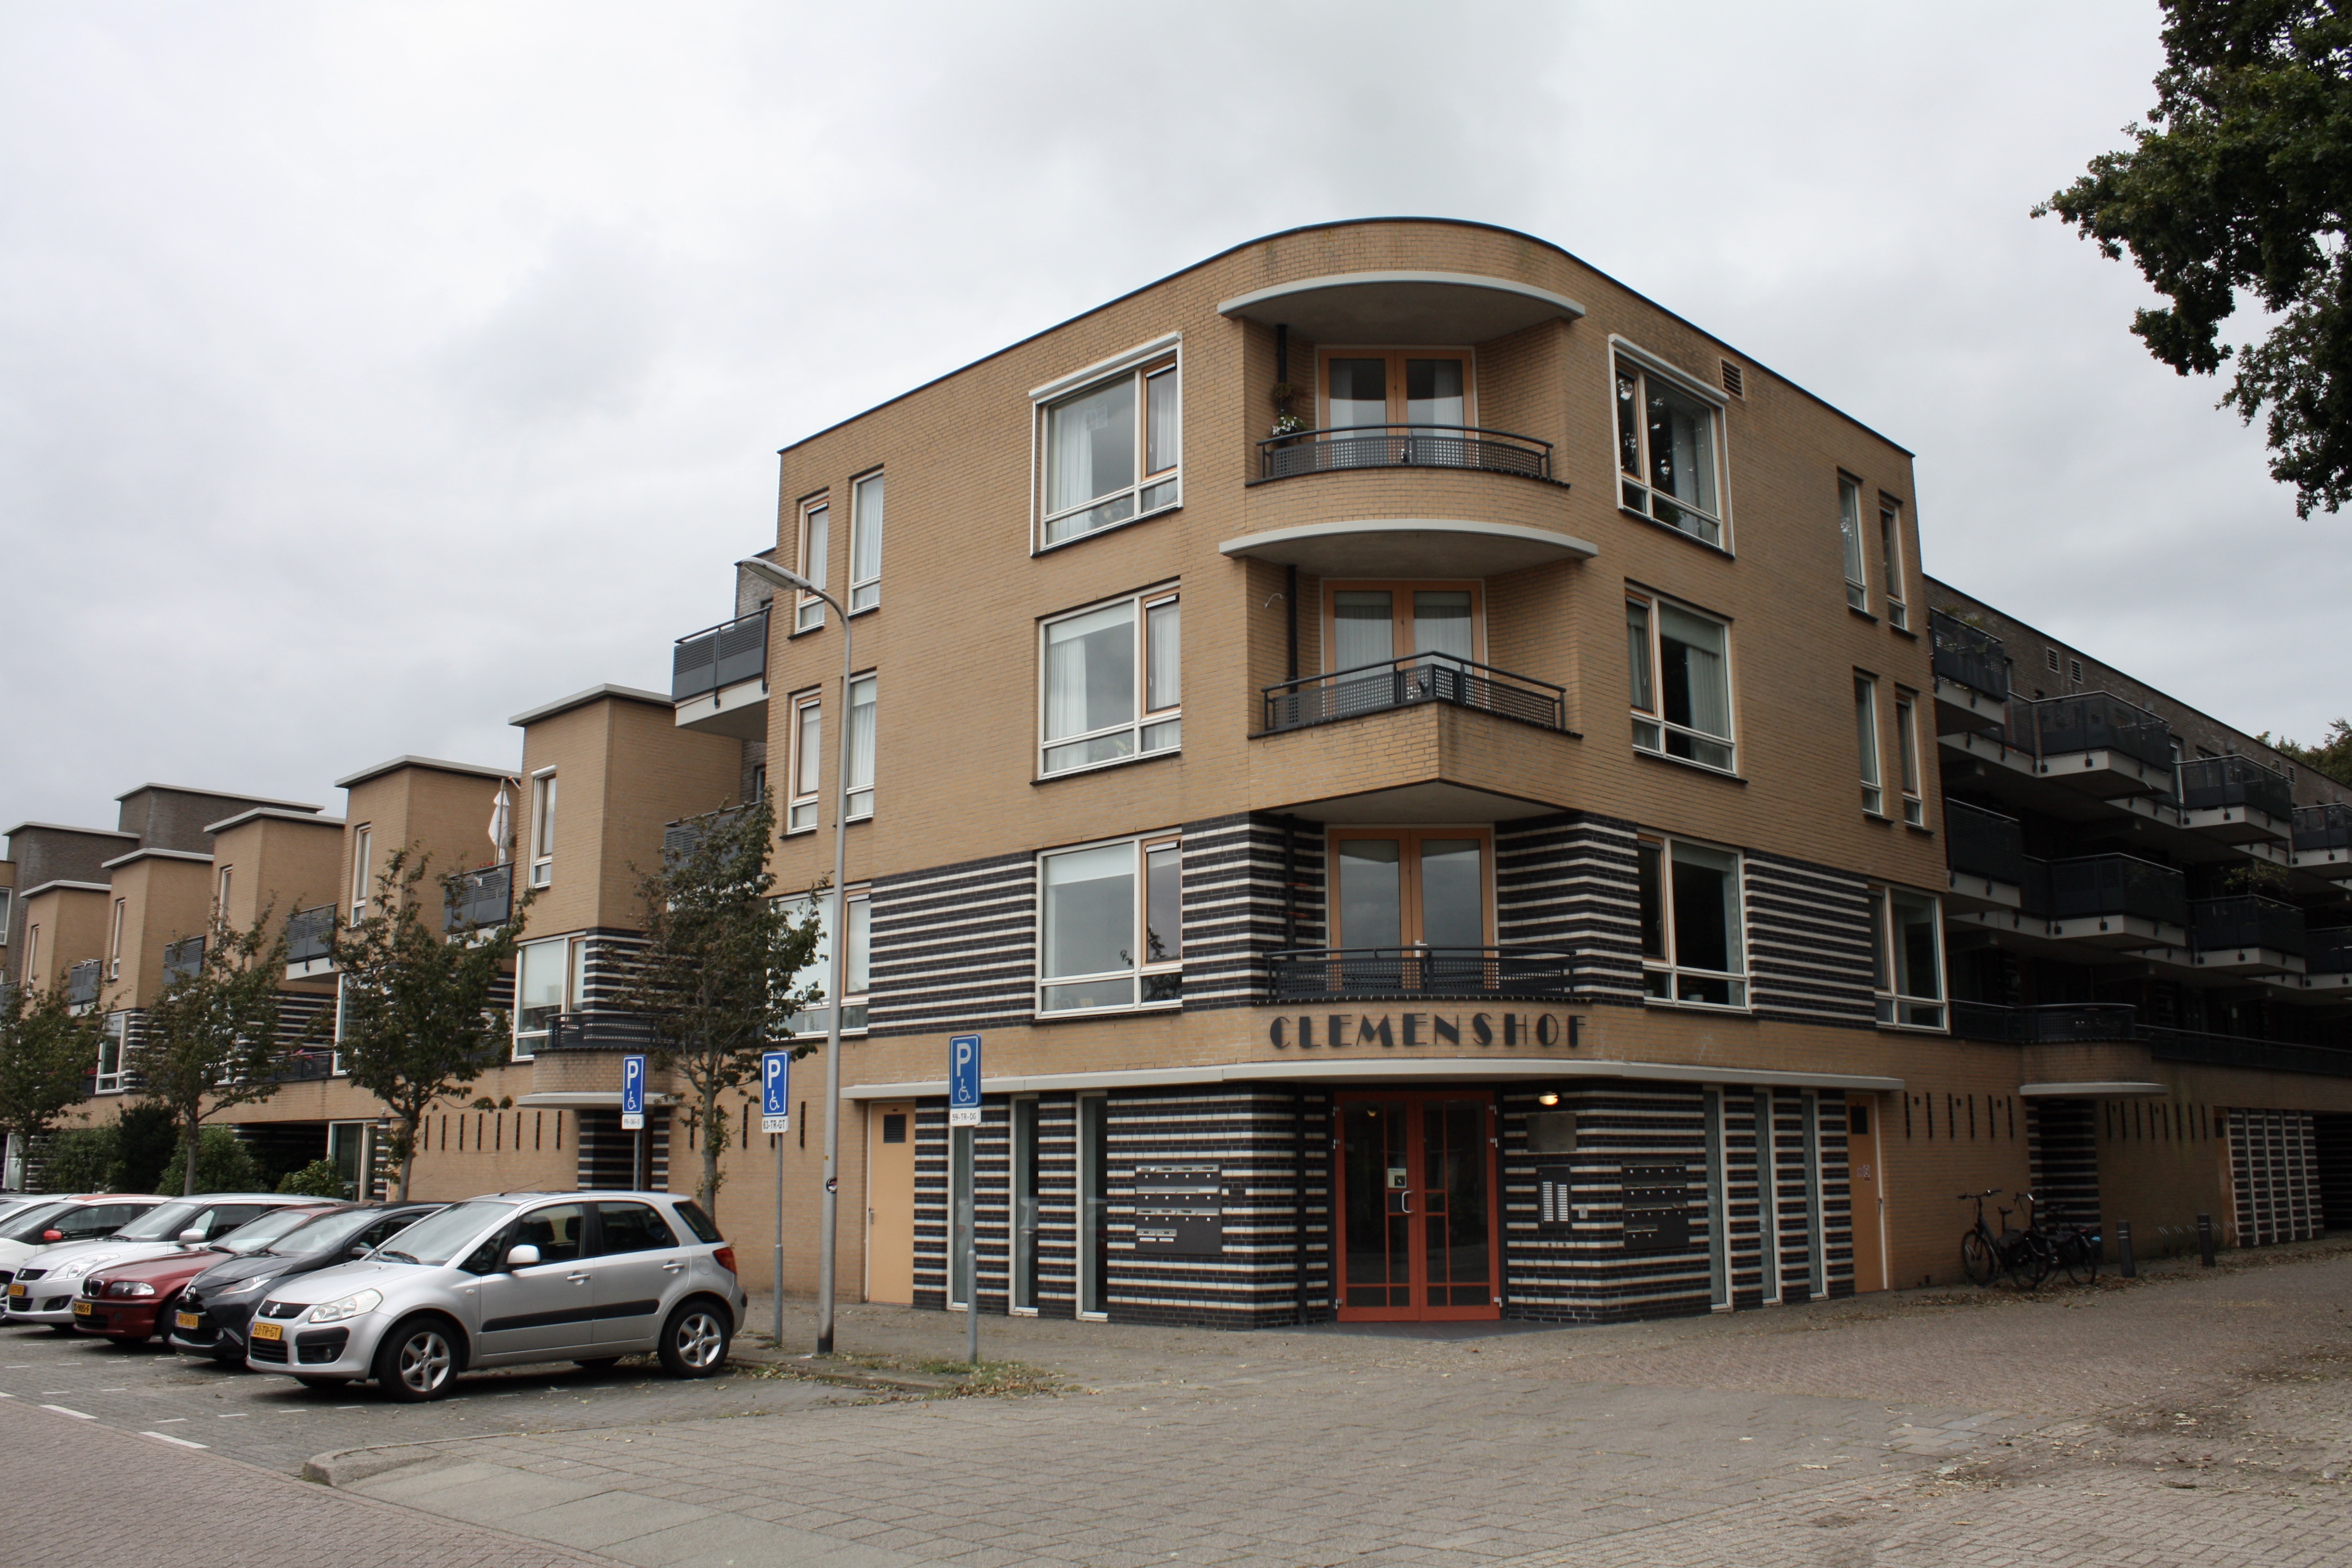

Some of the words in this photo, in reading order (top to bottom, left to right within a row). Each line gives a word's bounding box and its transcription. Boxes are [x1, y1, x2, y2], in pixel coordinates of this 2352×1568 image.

[1270, 1013, 1587, 1049] CLEMENSHOF
[627, 1060, 639, 1089] P
[768, 1059, 781, 1088] P
[956, 1043, 972, 1077] P
[763, 1119, 785, 1130] 63-TR-GT
[952, 1112, 977, 1122] 59-TR-DG
[254, 1325, 280, 1337] 63-TR-GT
